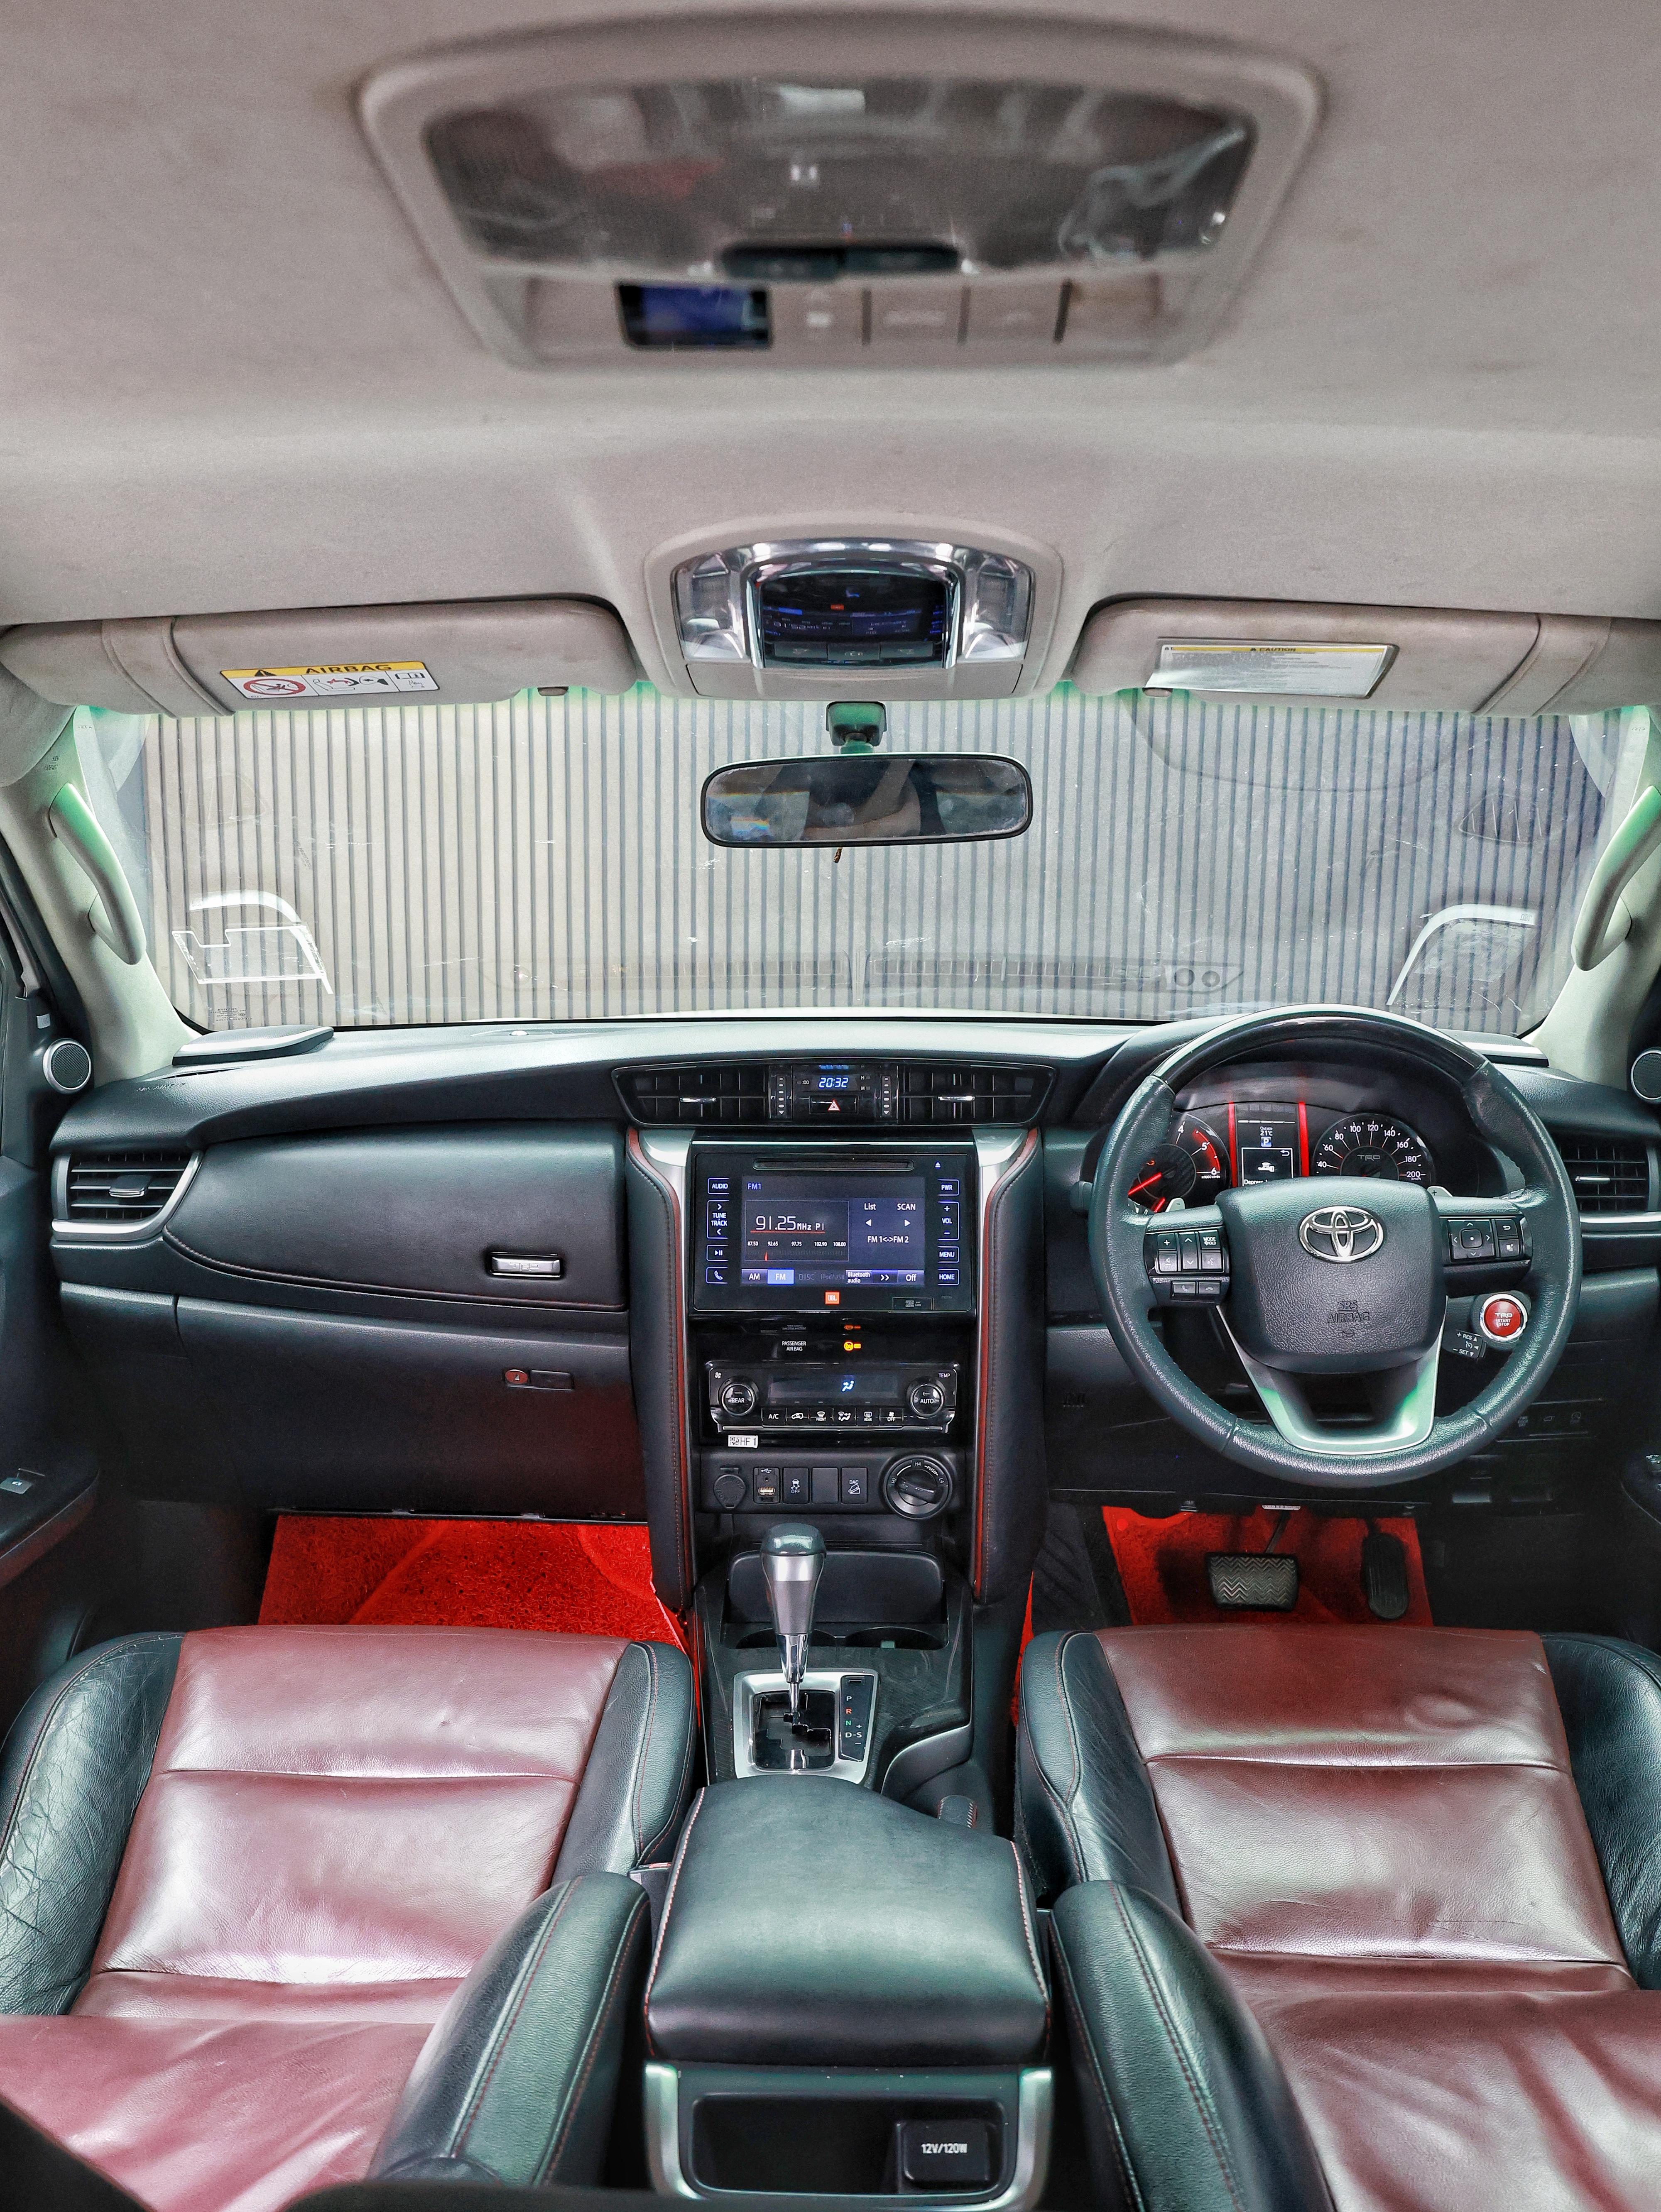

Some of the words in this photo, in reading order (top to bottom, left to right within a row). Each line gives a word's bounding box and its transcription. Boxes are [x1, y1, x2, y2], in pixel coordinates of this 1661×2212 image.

[306, 664, 392, 673] AIRBAG
[819, 1077, 848, 1088] 20:32
[1338, 1300, 1358, 1309] SRS
[1328, 1312, 1370, 1323] AIRBAG
[921, 2143, 968, 2153] 12V/120W
